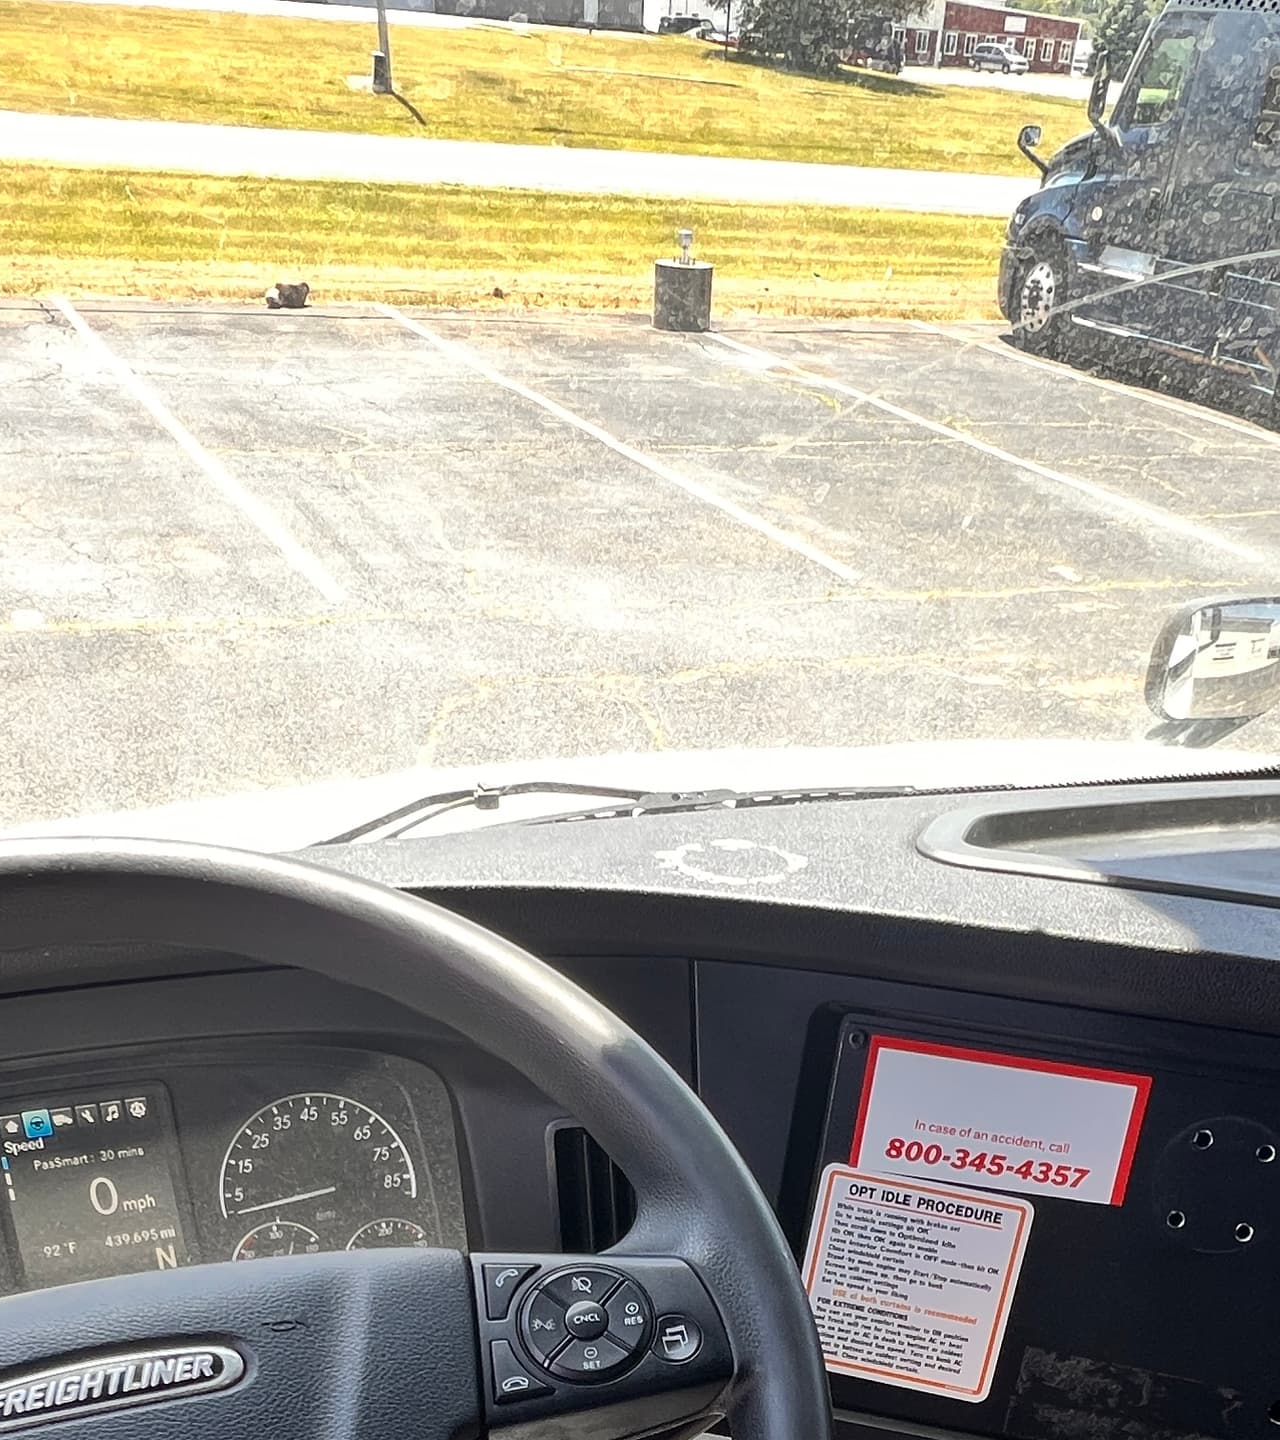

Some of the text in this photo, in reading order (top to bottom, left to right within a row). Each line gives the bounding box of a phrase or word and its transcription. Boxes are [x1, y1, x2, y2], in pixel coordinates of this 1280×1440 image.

[300, 1107, 318, 1121] 45
[331, 1112, 348, 1126] 55
[272, 1115, 291, 1130] 35
[353, 1125, 371, 1140] 65
[914, 1119, 1070, 1154] In case of an accident, call
[4, 1138, 44, 1156] Speed
[252, 1134, 270, 1149] 25
[100, 1149, 114, 1162] 30
[118, 1146, 145, 1159] mins
[372, 1147, 390, 1161] 75
[238, 1159, 253, 1173] 15
[885, 1138, 1090, 1188] 800-345-4357
[384, 1174, 402, 1188] 85
[89, 1177, 156, 1216] 0 mph
[234, 1187, 244, 1201] 5
[849, 1183, 1003, 1225] OPT IDLE PROCEDURE
[159, 1227, 176, 1240] mi
[842, 1229, 854, 1237] OK
[873, 1235, 885, 1243] OK
[916, 1226, 929, 1234] OK
[43, 1244, 61, 1258] 92
[155, 1245, 177, 1270] N
[987, 1266, 999, 1275] OK
[816, 1296, 908, 1321] FOR EXTREME CONDITIONS
[572, 1313, 600, 1325] CNCL
[624, 1316, 644, 1326] RES
[583, 1360, 601, 1370] SET
